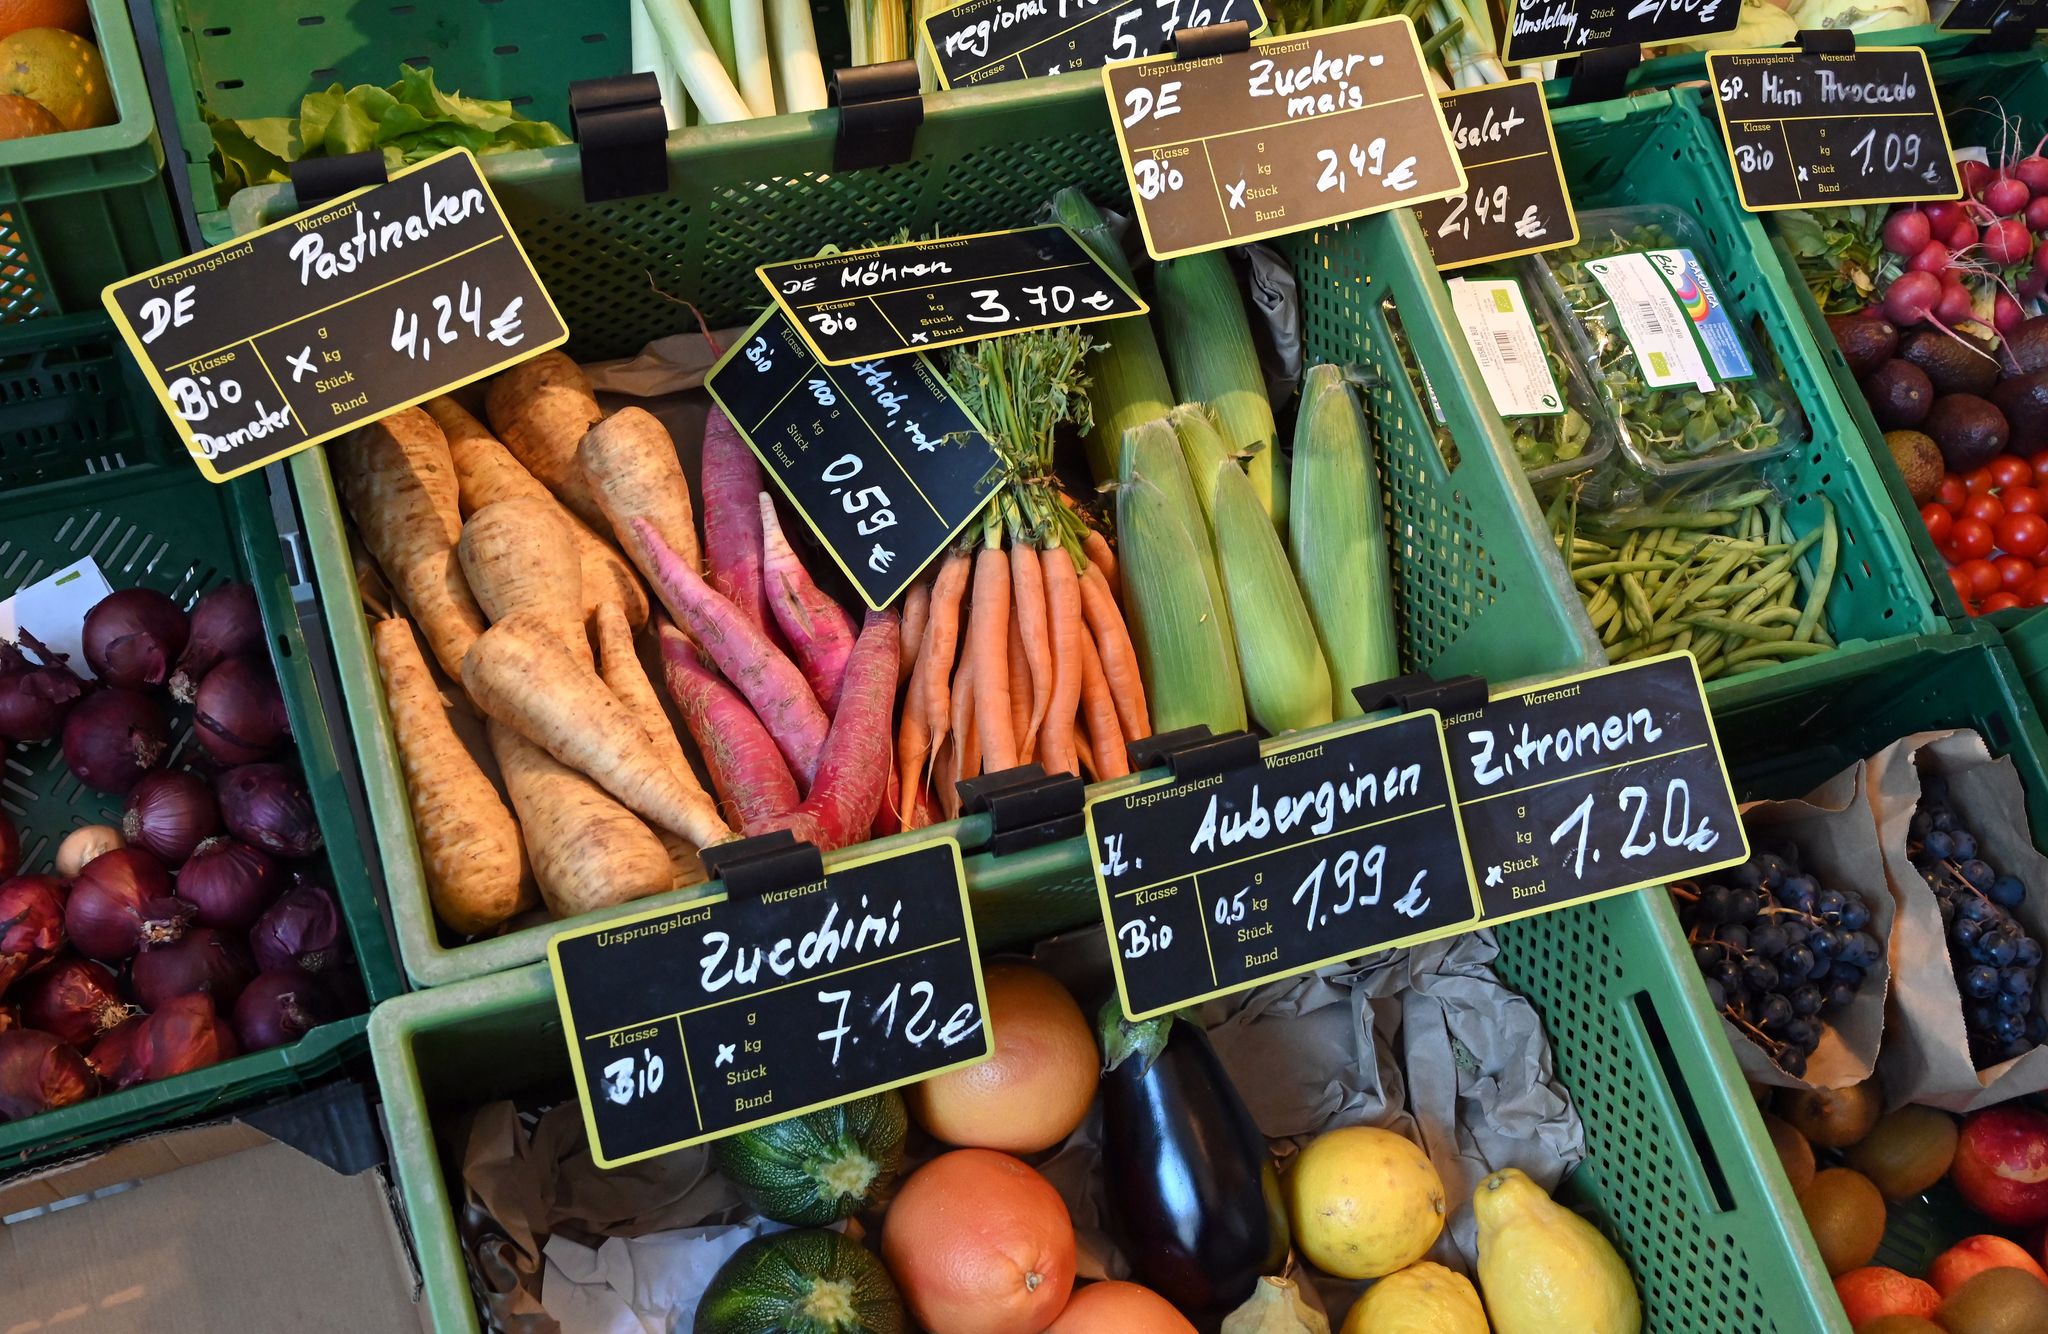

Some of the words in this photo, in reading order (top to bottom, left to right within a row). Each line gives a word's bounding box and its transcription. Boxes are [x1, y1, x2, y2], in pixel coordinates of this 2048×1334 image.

[1590, 8, 1615, 20] Stück
[945, 0, 1048, 57] regional
[1588, 27, 1613, 40] Bund
[1068, 40, 1076, 50] g
[1068, 57, 1083, 69] kg
[1138, 55, 1224, 78] Ursprungsland
[1258, 40, 1311, 57] Warenart
[1732, 54, 1795, 66] Ursprungsland
[1820, 53, 1856, 62] Warenart
[970, 64, 1006, 84] Klasse
[1124, 82, 1182, 128] DE
[1248, 49, 1384, 97] Zucker-
[1762, 70, 1801, 107] Mini
[1287, 82, 1363, 119] mais
[1440, 98, 1457, 109] art
[1743, 122, 1771, 132] Klasse
[1820, 128, 1826, 137] g
[1151, 146, 1190, 161] Klasse
[1257, 141, 1265, 153] g
[1734, 143, 1774, 173] Bio
[1820, 146, 1831, 156] kg
[1135, 159, 1185, 201] Bio
[1257, 162, 1271, 176] kg
[1812, 164, 1835, 174] Stück
[1246, 184, 1279, 200] Stück
[1818, 183, 1840, 193] Bund
[1255, 206, 1286, 222] Bund
[148, 242, 254, 290] Ursprungsland
[294, 200, 359, 233] Warenart
[793, 251, 881, 272] Ursprungsland
[916, 238, 970, 253] Warenart
[139, 285, 197, 345] DE
[289, 182, 485, 287] Pastinaken
[1650, 254, 1674, 276] Bio
[782, 276, 818, 295] DE
[840, 260, 952, 288] Möhren
[1687, 259, 1720, 309] BARDUCA
[815, 300, 856, 314] Klasse
[927, 292, 935, 301] g
[966, 285, 1075, 323] 3.70
[929, 303, 945, 314] kg
[808, 313, 858, 336] Bio
[920, 313, 954, 327] Stück
[317, 325, 328, 340] g
[932, 325, 964, 338] Bund
[780, 326, 806, 360] Klasse
[188, 350, 236, 376] Klasse
[322, 348, 341, 365] kg
[745, 337, 772, 373] Bio
[315, 370, 356, 395] Stück
[911, 357, 949, 404] Warenart
[168, 376, 242, 421] Bio
[331, 392, 369, 415] Bund
[807, 378, 836, 407] 100
[830, 408, 840, 419] g
[191, 399, 293, 460] Demeter
[785, 422, 809, 453] Stück
[812, 419, 825, 437] kg
[771, 441, 793, 469] Bund
[1441, 707, 1483, 730] gsland
[1522, 684, 1581, 707] Warenart
[1468, 707, 1663, 786] Zitronen
[1125, 773, 1224, 809] Ursprungsland
[1264, 745, 1324, 770] Warenart
[1190, 763, 1421, 855] Auberginen
[1517, 806, 1526, 818] g
[1516, 830, 1533, 844] kg
[1502, 854, 1540, 875] Stück
[1254, 872, 1263, 885] g
[1135, 886, 1179, 906] Klasse
[1511, 881, 1547, 899] Bund
[596, 907, 712, 949] Ursprungsland
[760, 878, 829, 906] Warenart
[1252, 898, 1268, 912] kg
[1118, 915, 1173, 959] Bio
[1237, 922, 1273, 942] Stück
[700, 894, 902, 993] Zucchini
[1244, 946, 1279, 969] Bund
[747, 1012, 757, 1026] g
[608, 1025, 659, 1049] Klasse
[744, 1038, 762, 1054] kg
[602, 1047, 664, 1106] Bio
[726, 1064, 768, 1087] Stück
[734, 1090, 774, 1112] Bund
